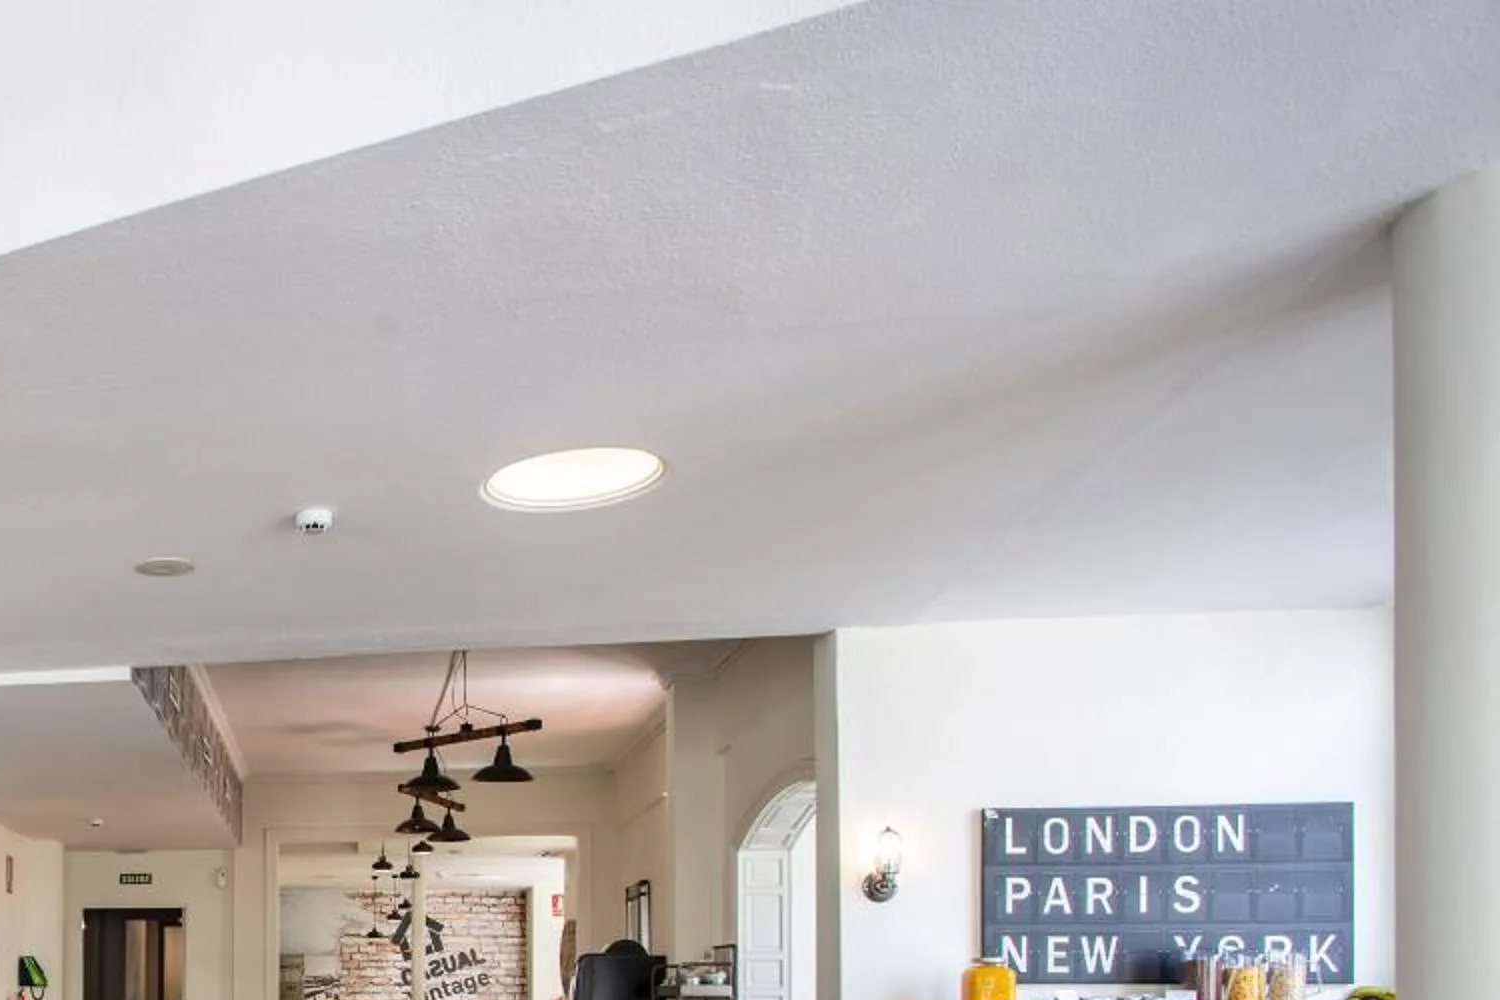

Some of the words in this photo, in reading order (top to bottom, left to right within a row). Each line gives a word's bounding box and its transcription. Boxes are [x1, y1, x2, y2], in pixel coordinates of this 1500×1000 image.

[1005, 814, 1246, 855] LONDON
[1005, 875, 1202, 915] PARIS
[1000, 934, 1119, 975] NEW
